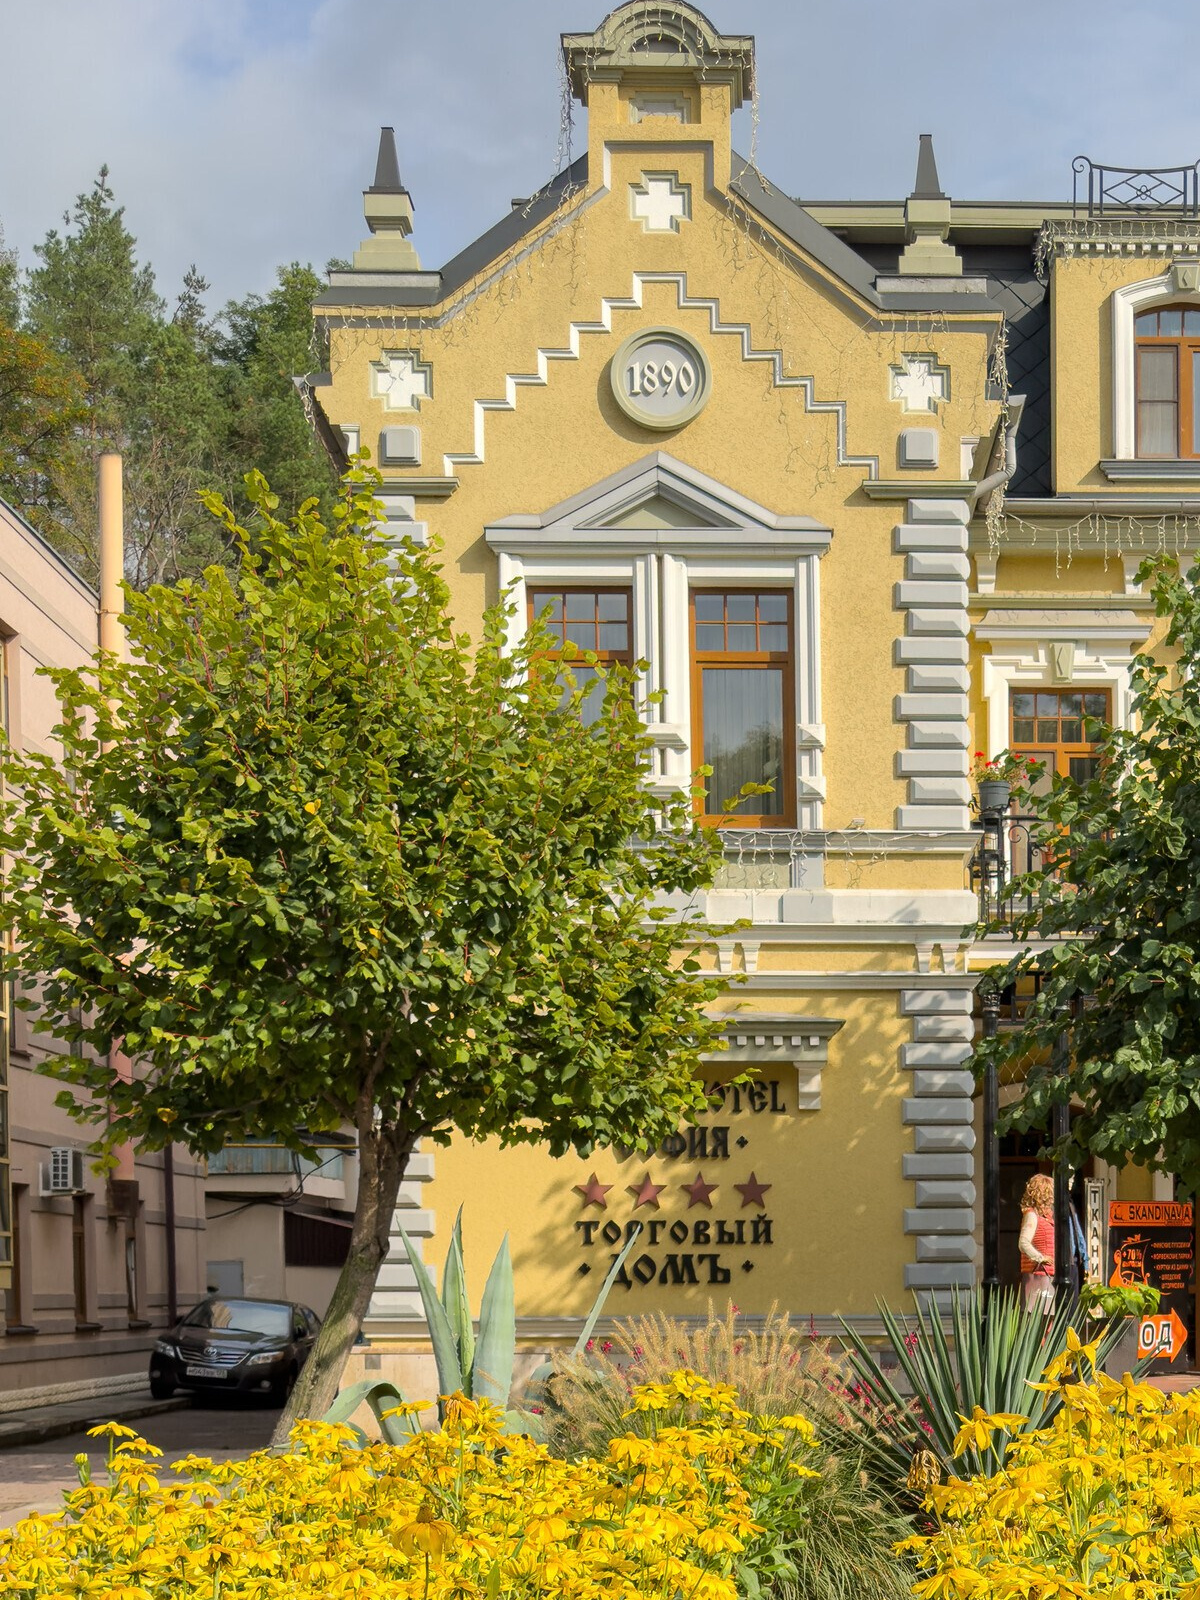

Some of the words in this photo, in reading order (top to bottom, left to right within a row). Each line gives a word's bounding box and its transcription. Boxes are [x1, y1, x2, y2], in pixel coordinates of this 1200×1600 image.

[628, 360, 695, 397] 1890
[693, 1080, 786, 1112] OTEL
[624, 1126, 731, 1158] ФИЯ
[1128, 1205, 1190, 1220] SKANDINAVIA
[576, 1213, 774, 1249] ТОРГОВЫЙ
[1091, 1190, 1099, 1276] ТКАНИ
[603, 1253, 731, 1290] ДОМЪ
[1139, 1321, 1172, 1353] ОД
